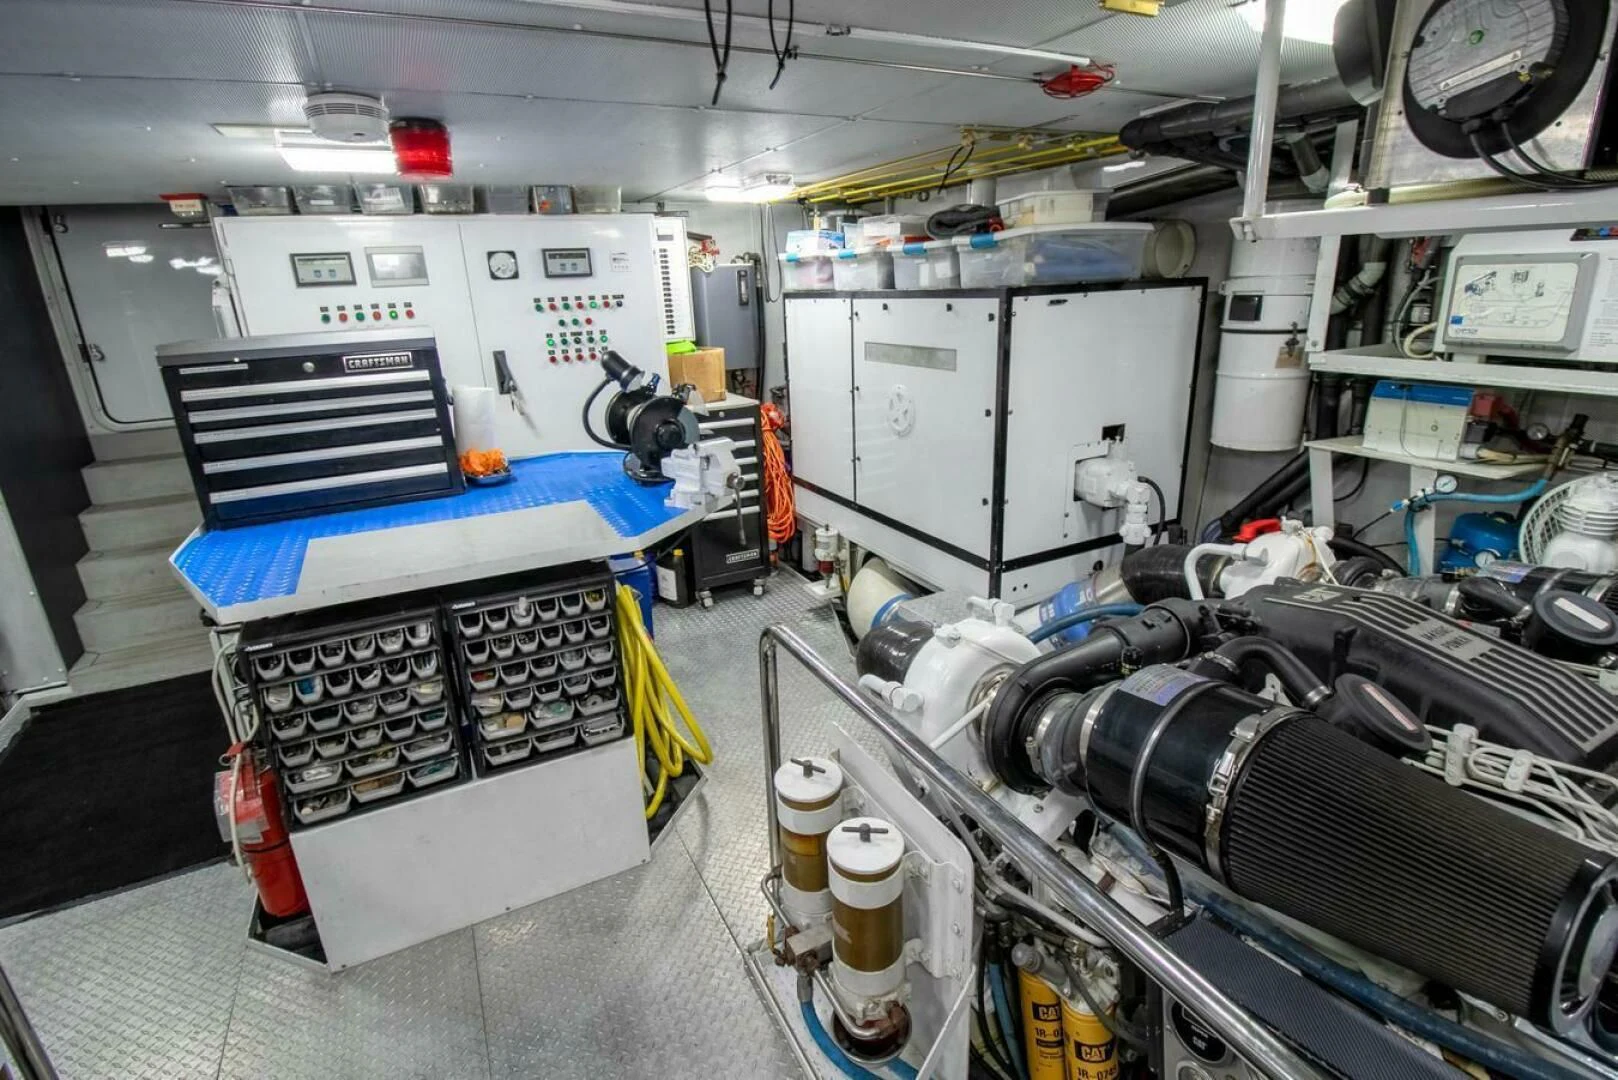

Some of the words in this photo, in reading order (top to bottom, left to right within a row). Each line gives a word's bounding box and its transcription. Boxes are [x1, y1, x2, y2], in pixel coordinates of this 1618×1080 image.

[348, 355, 408, 369] CRAFTSMAN
[1035, 1027, 1063, 1039] 1R-0
[1080, 1045, 1107, 1061] CAT
